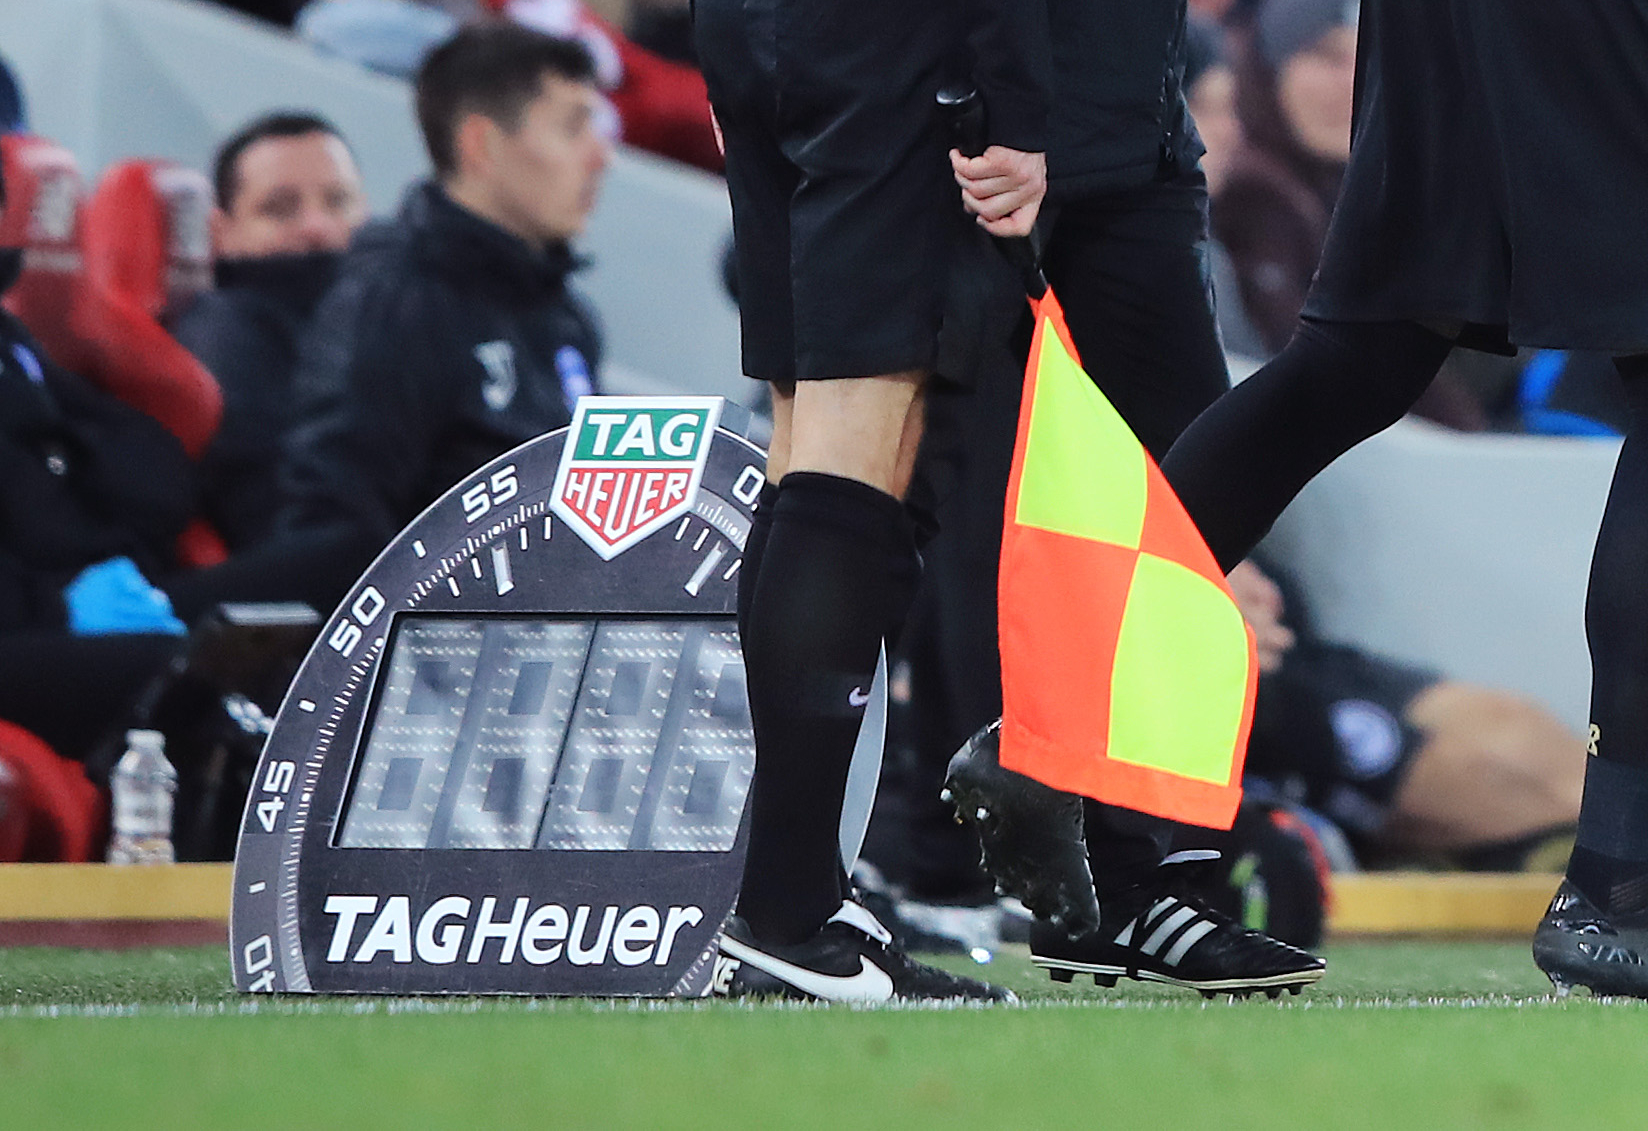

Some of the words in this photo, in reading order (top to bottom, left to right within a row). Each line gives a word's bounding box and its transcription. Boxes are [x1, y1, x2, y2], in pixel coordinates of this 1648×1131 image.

[587, 413, 700, 457] TAG
[461, 464, 519, 524] 55
[565, 472, 689, 541] HEUER
[328, 586, 386, 658] 50
[255, 761, 297, 833] 45
